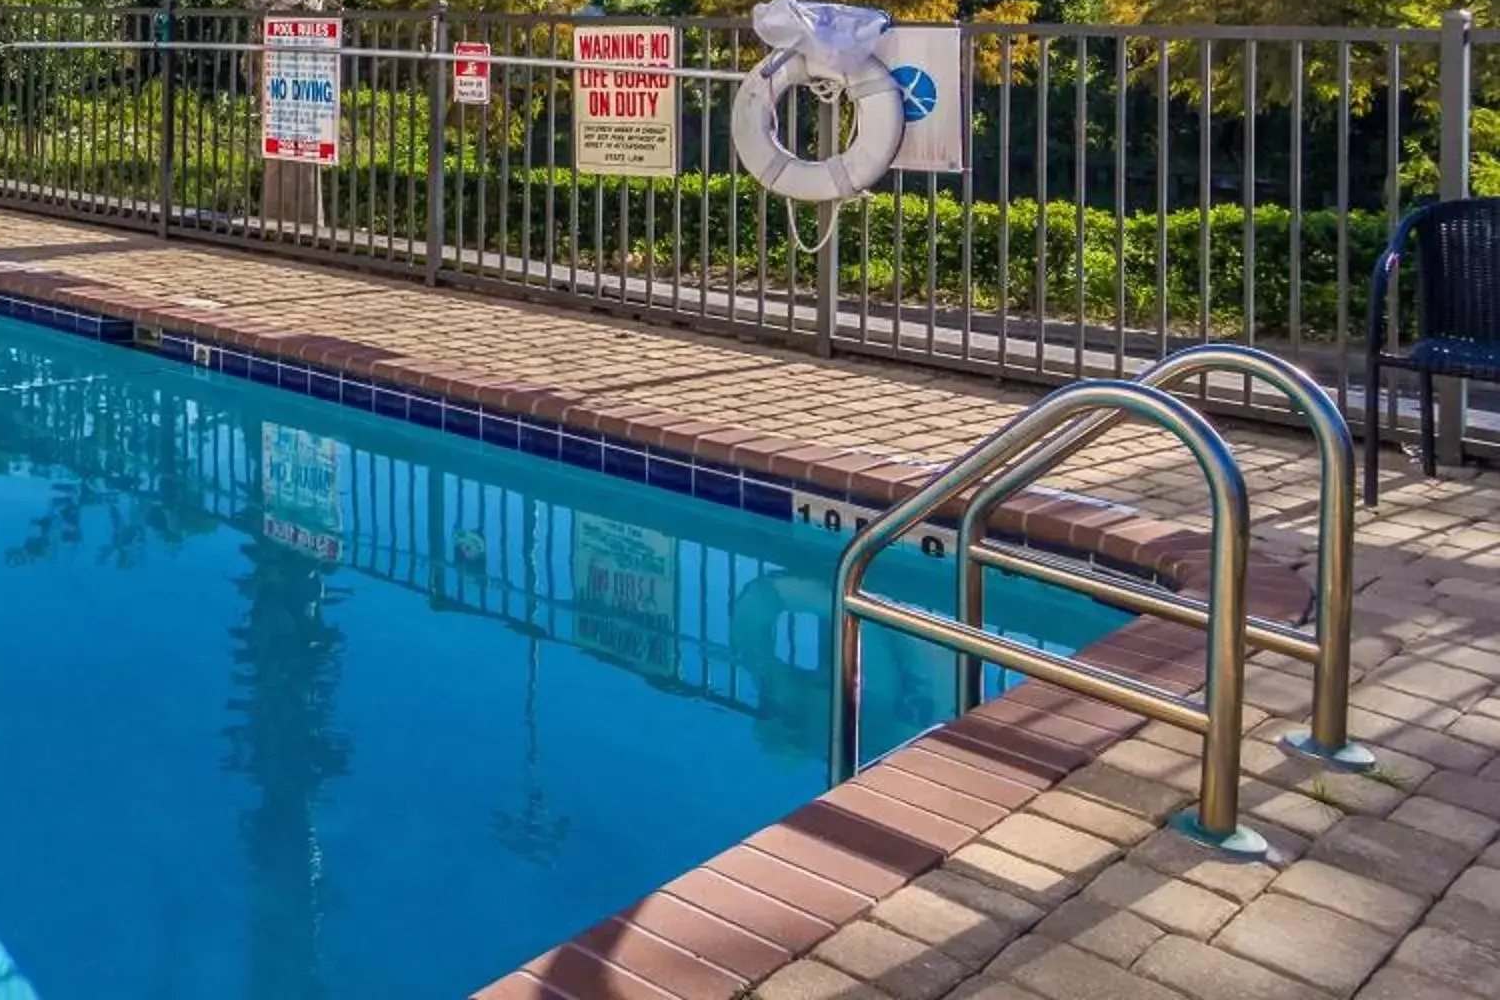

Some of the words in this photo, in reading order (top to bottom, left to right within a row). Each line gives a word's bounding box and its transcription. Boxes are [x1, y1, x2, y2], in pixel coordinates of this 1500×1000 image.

[273, 23, 295, 36] POOL
[298, 24, 329, 37] RULES
[579, 34, 645, 60] WARNING
[651, 33, 669, 60] NO
[579, 64, 609, 89] LIFE
[613, 63, 669, 89] GUARD
[271, 78, 287, 100] NO
[292, 79, 332, 103] DIVING
[589, 92, 610, 117] ON
[615, 92, 659, 118] DUTY
